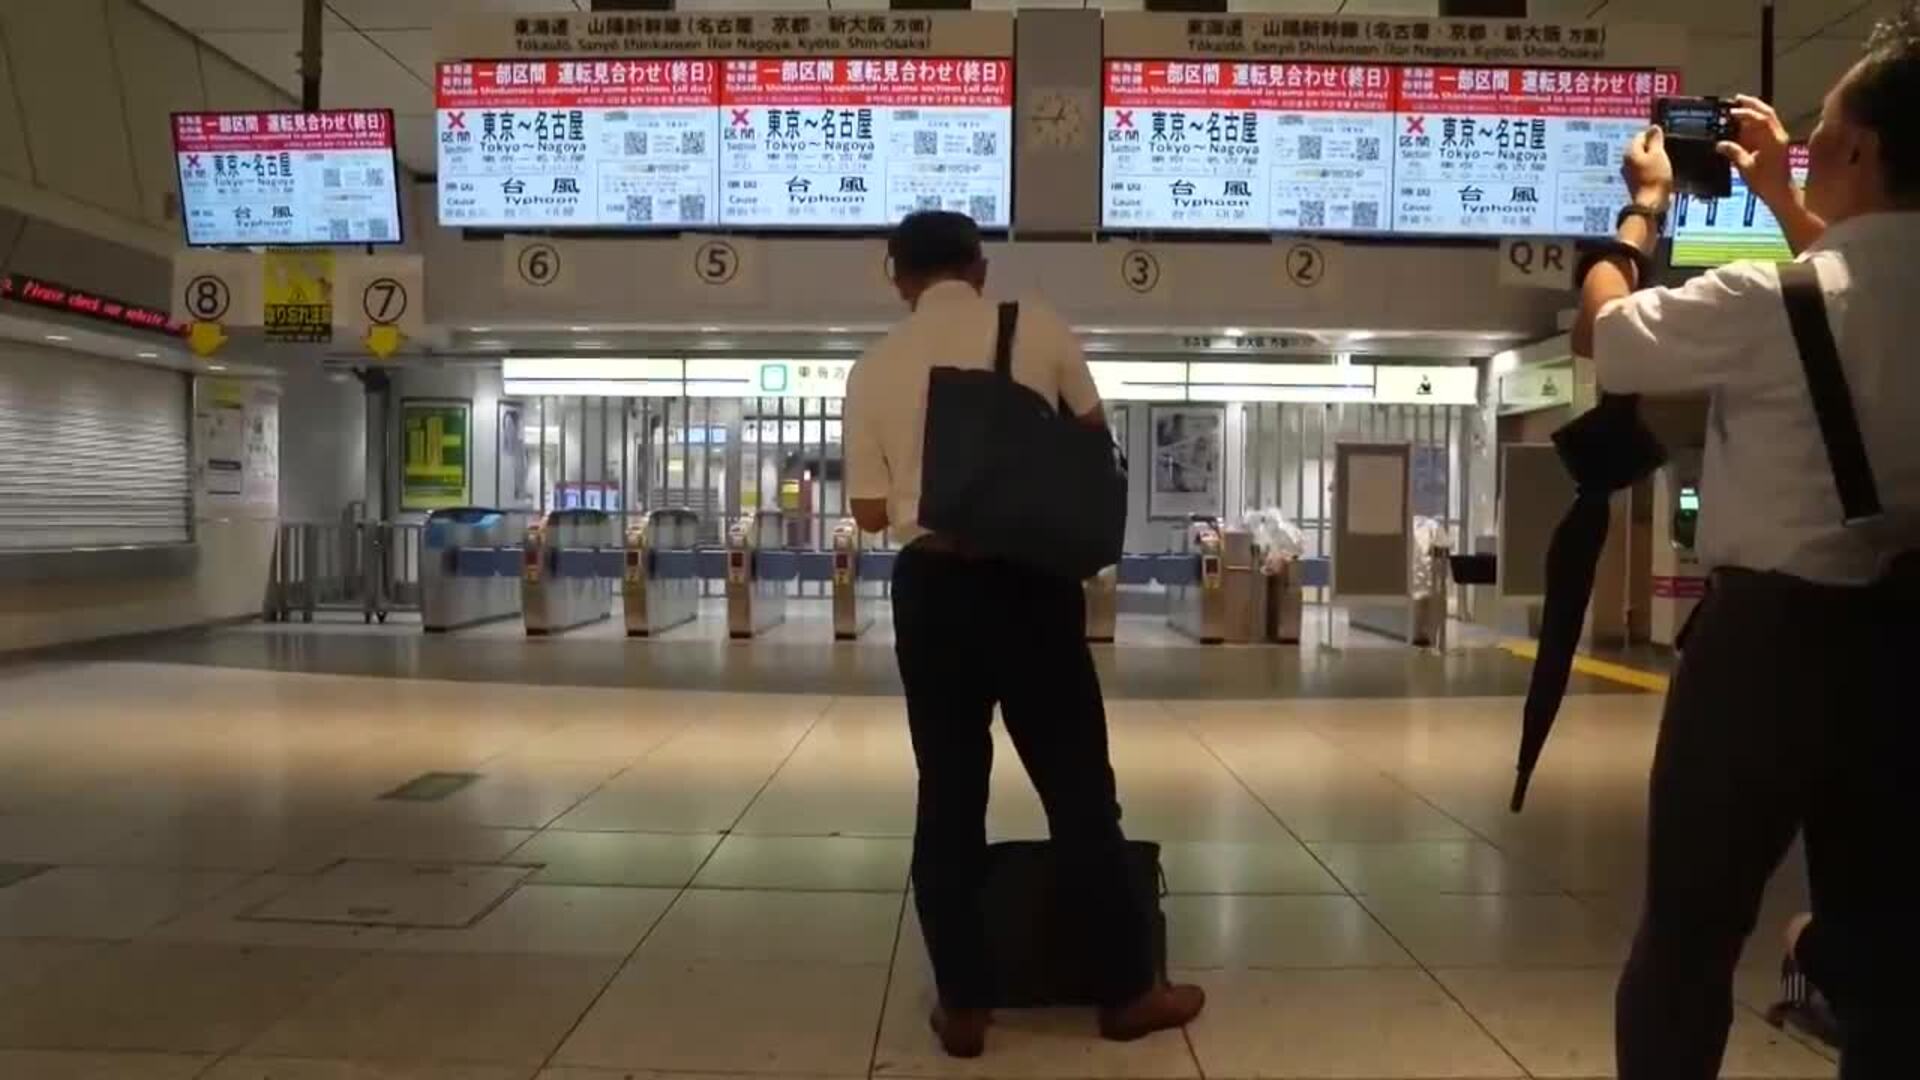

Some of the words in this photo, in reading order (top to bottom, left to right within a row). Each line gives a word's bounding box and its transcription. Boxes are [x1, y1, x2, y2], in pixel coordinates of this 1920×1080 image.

[478, 62, 547, 84] 一部区間
[763, 60, 834, 82] 一部区間
[1149, 62, 1219, 85] 一部区間
[1440, 68, 1510, 91] 一部区間
[482, 110, 585, 141] 東京～名古屋
[767, 108, 872, 139] 東京～名古屋
[1151, 111, 1258, 143] 東京～名古屋
[1441, 117, 1546, 149] 東京～名古屋
[504, 195, 578, 206] Typhoon
[789, 193, 865, 204] Typhoon
[1173, 196, 1250, 208] Typhoon
[1462, 203, 1536, 214] Typhoon
